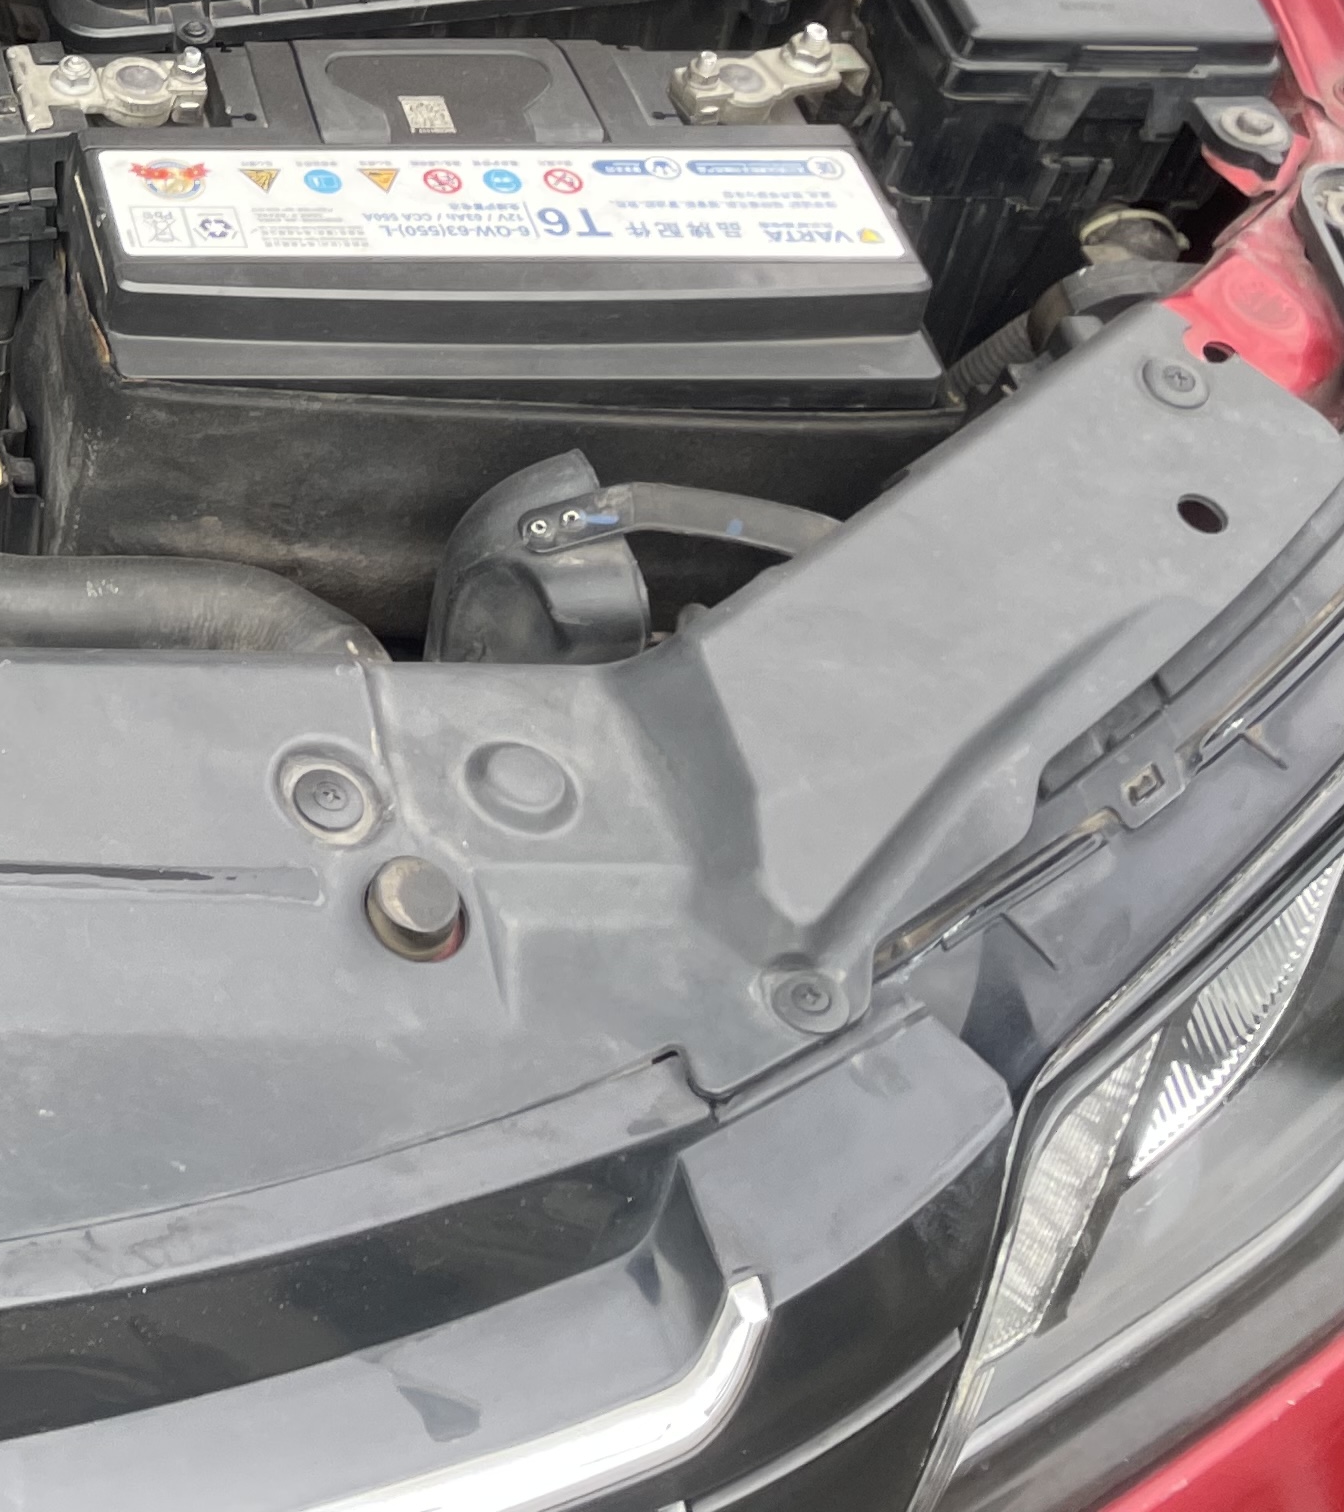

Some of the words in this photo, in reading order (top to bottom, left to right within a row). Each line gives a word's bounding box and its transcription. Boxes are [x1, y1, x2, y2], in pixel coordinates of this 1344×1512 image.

[402, 213, 433, 223] CCA
[497, 213, 525, 223] 12V
[537, 207, 614, 237] T6
[378, 223, 531, 238] 6-QW-63(550)-L
[625, 221, 743, 239] 品牌配件
[766, 229, 855, 244] VARTA
